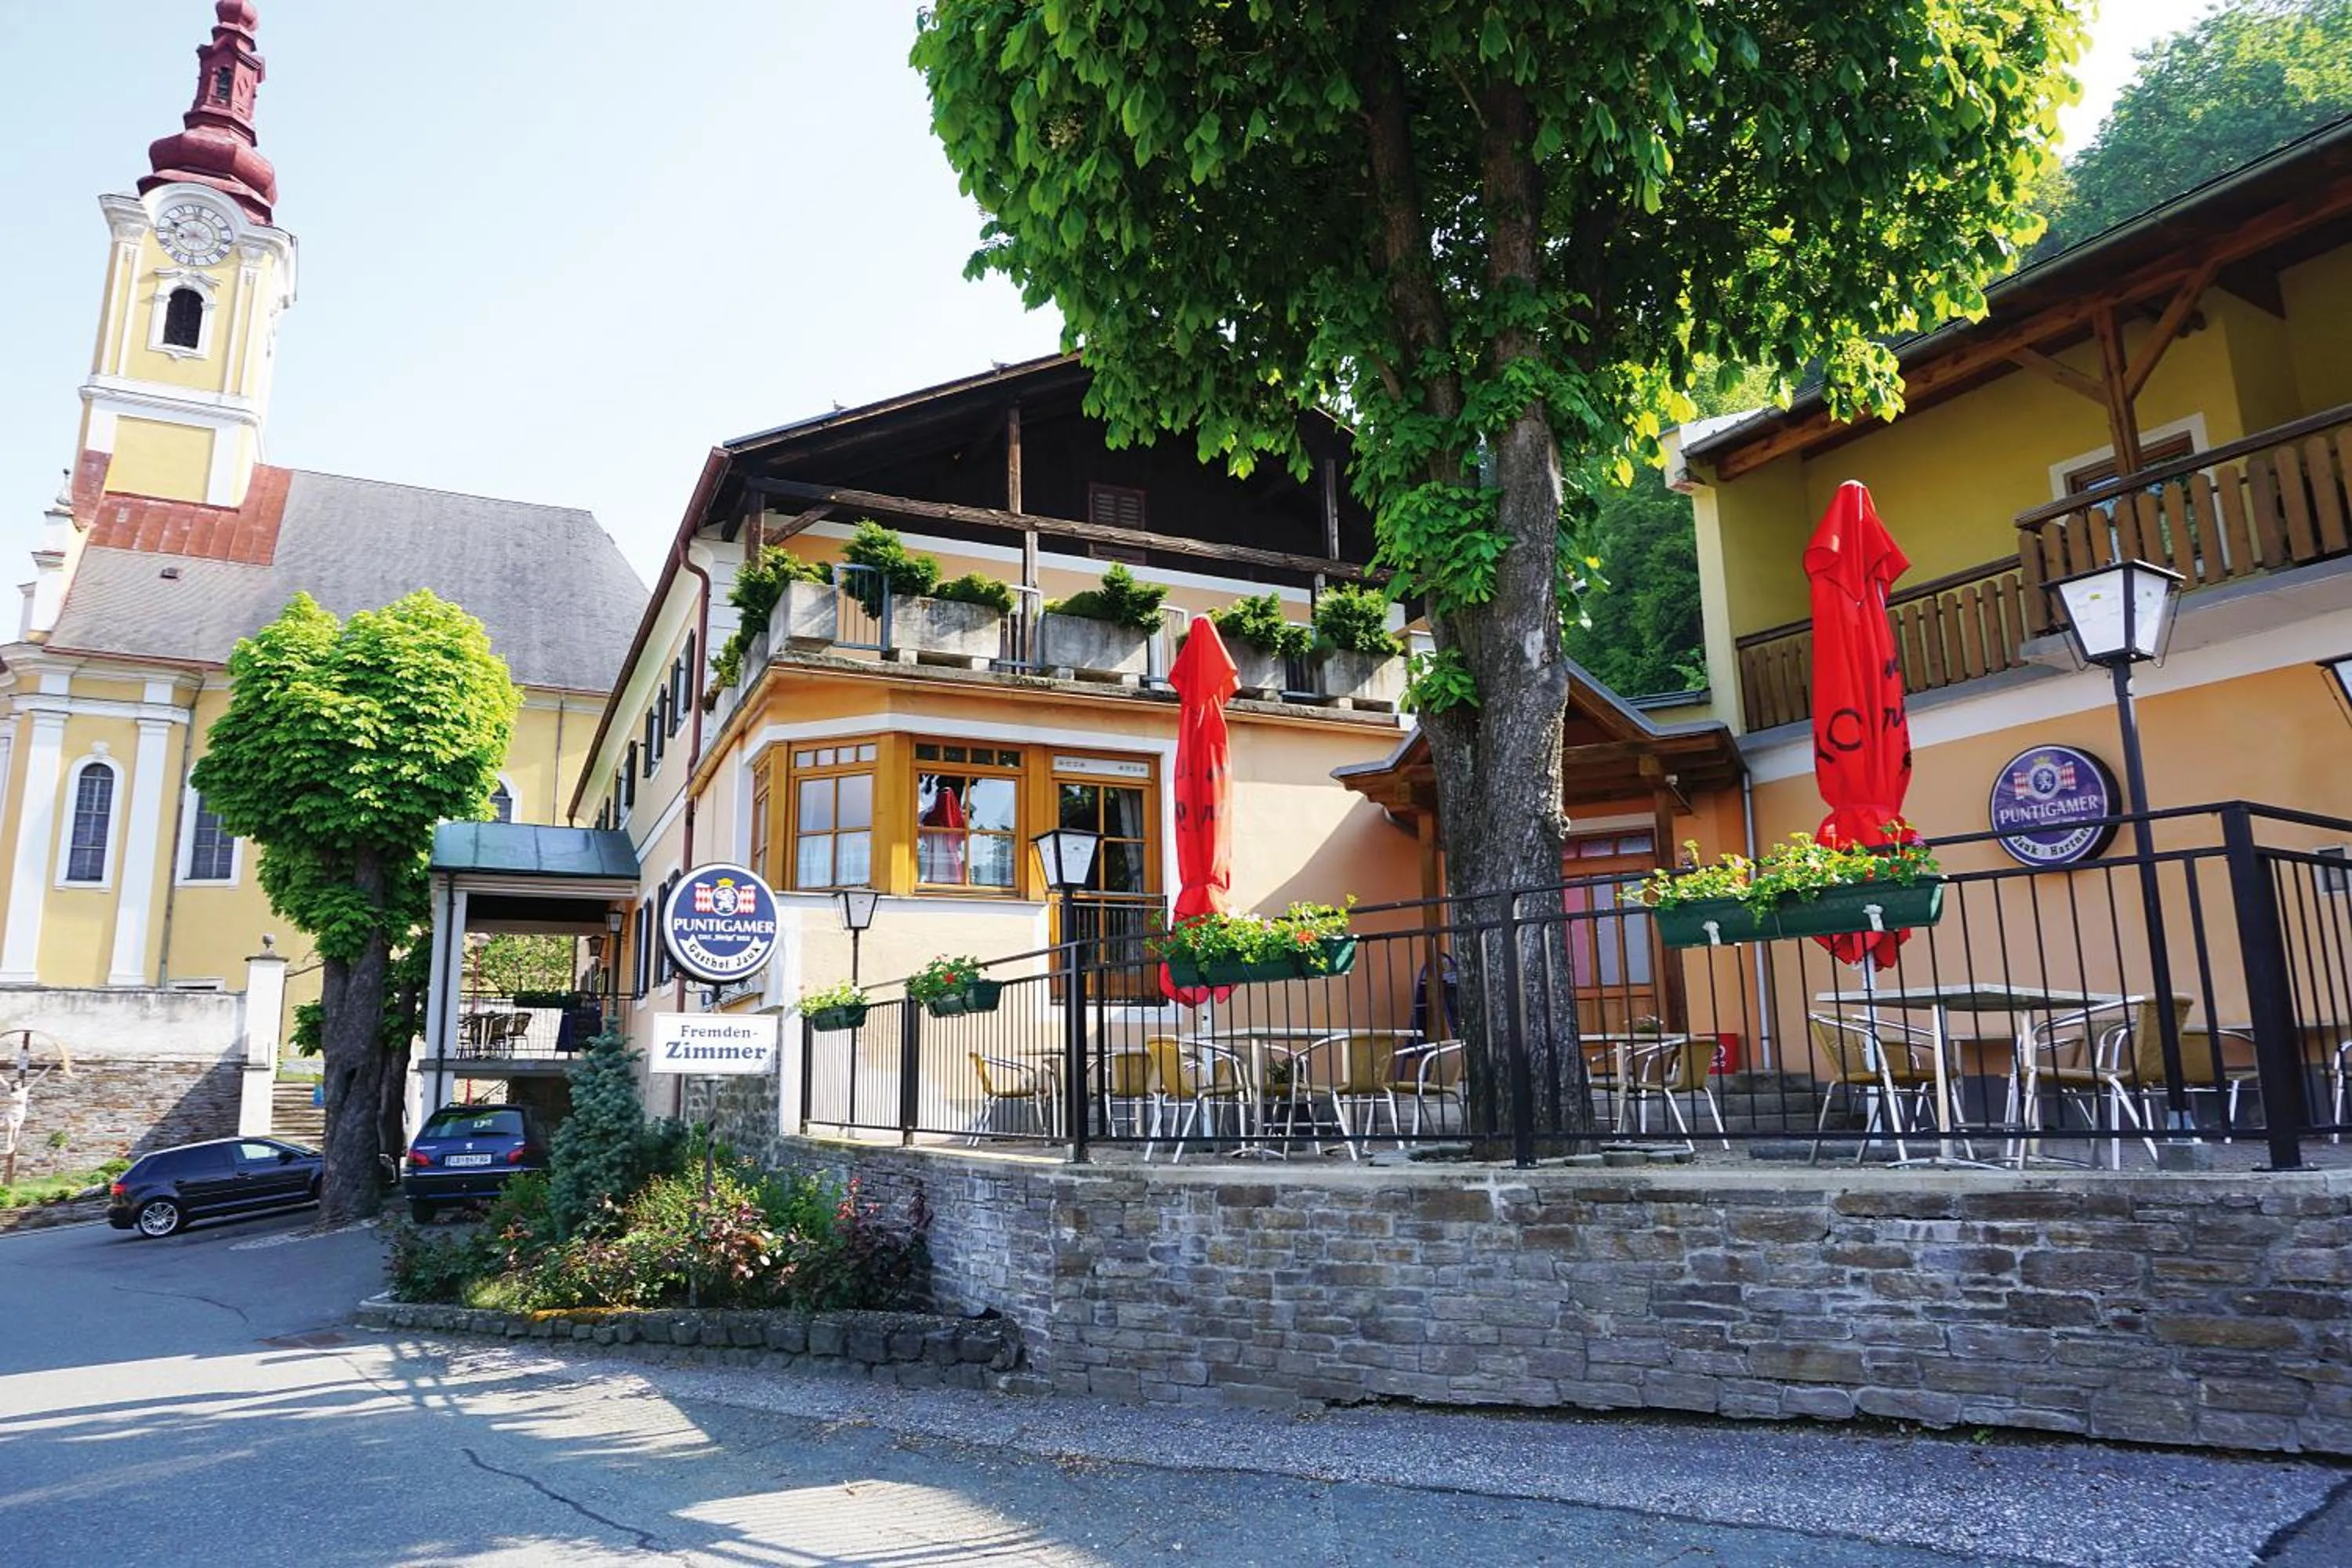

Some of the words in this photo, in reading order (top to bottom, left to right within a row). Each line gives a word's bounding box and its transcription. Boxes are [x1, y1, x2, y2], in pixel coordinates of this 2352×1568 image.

[2000, 794, 2099, 824] PUNTIGAMER
[673, 917, 775, 934] PUNTIGAMER
[688, 943, 729, 969] Gasthof
[736, 946, 761, 967] Jauk
[681, 1025, 758, 1038] Fremden-
[666, 1040, 768, 1059] Zimmer
